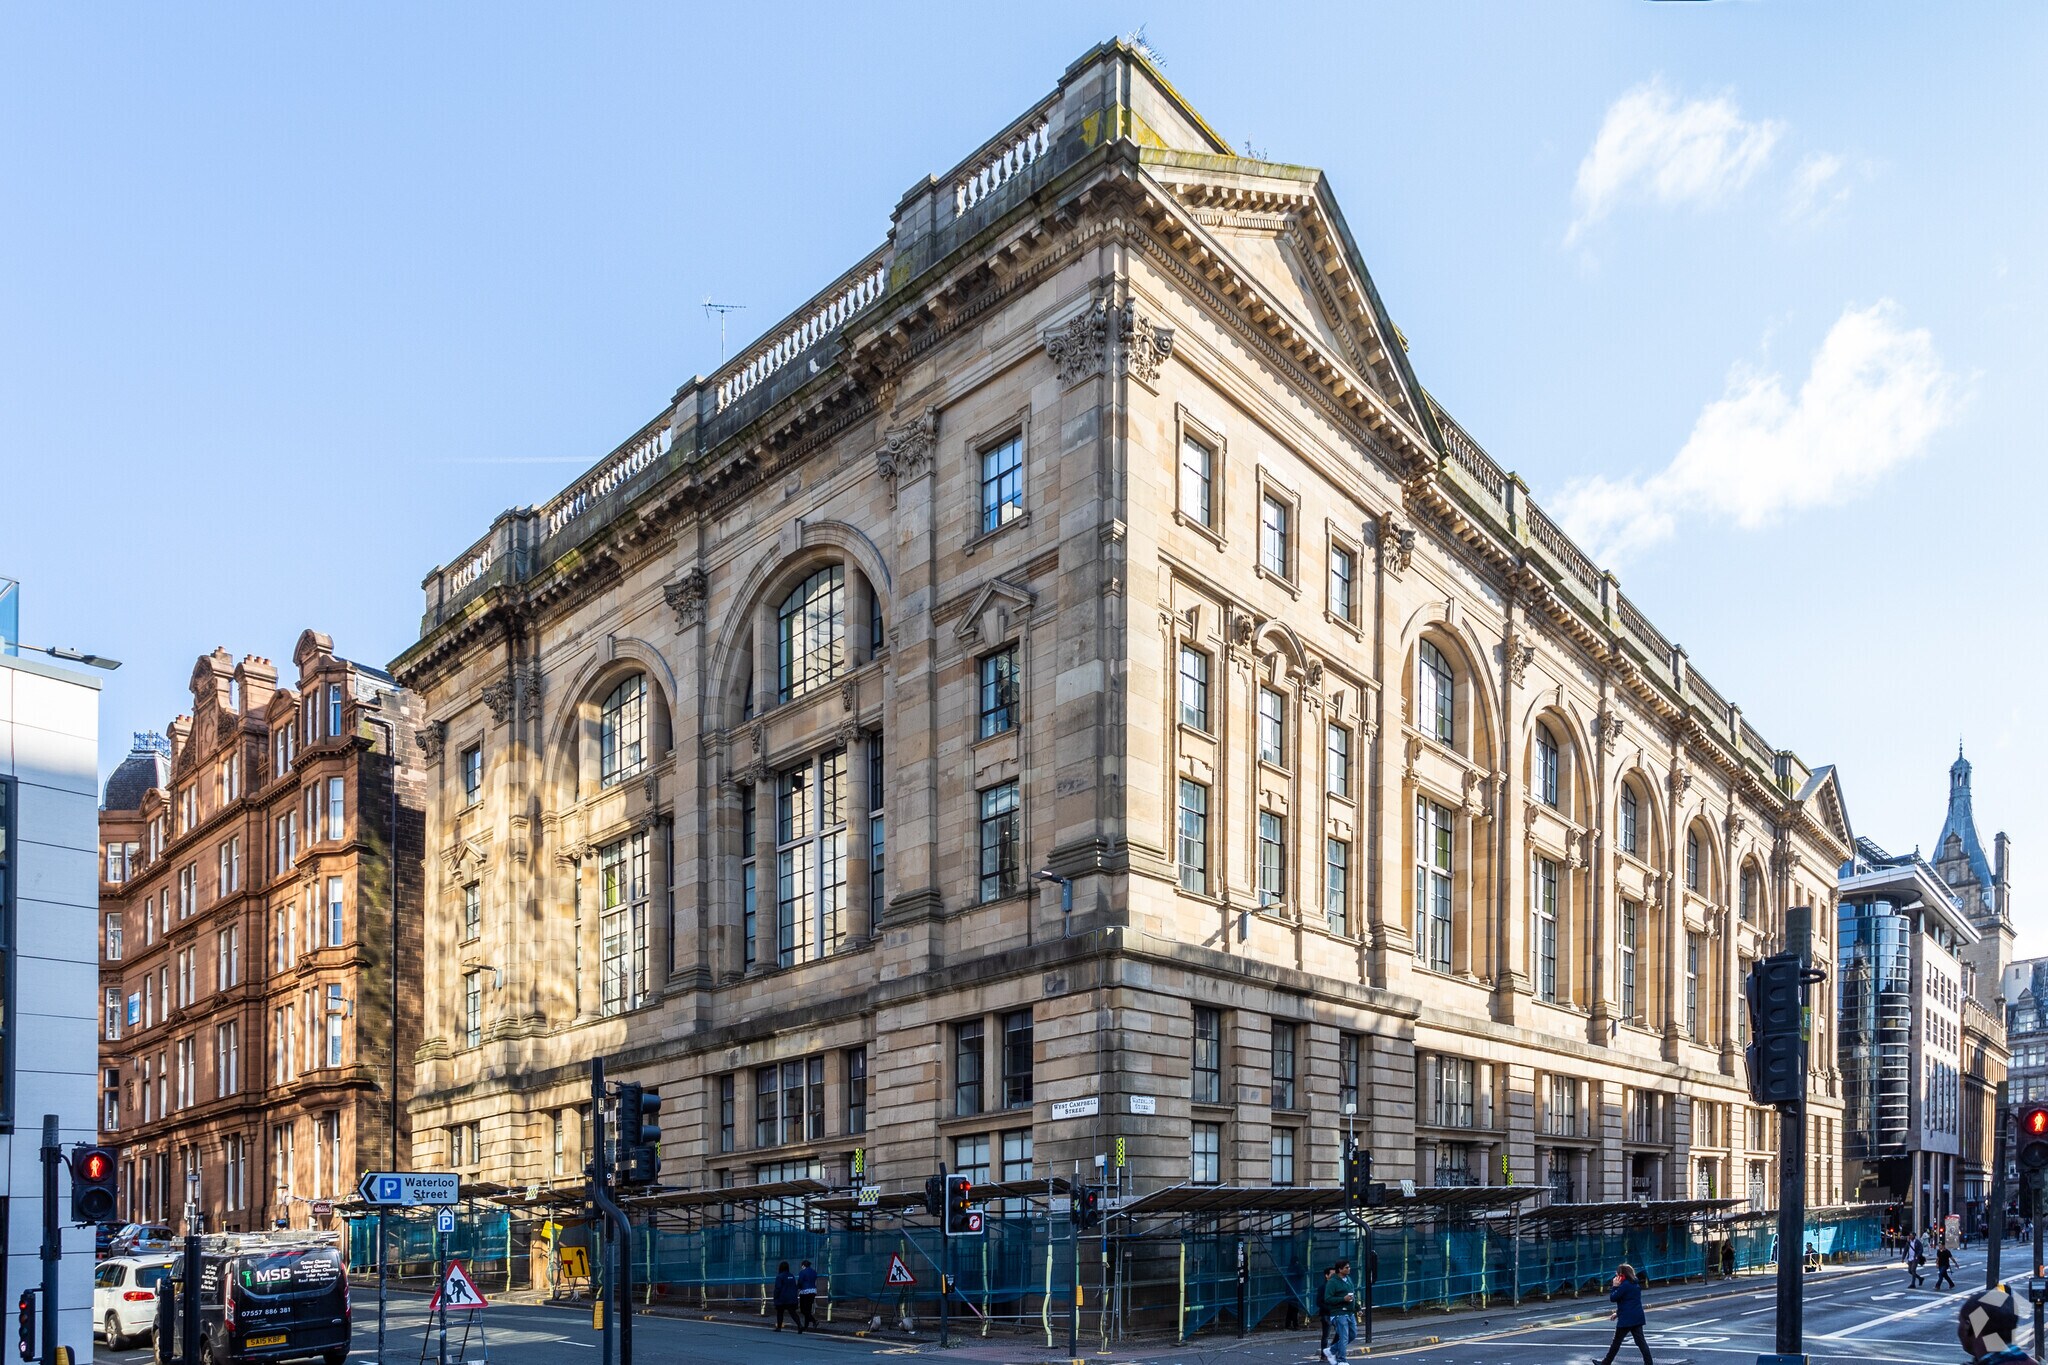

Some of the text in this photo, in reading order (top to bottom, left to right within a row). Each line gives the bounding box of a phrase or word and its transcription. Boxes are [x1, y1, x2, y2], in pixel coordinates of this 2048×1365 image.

[1069, 1100, 1097, 1108] CAMPBELL
[405, 1178, 454, 1187] Waterloo
[413, 1190, 448, 1199] Street
[256, 1268, 291, 1282] MSB
